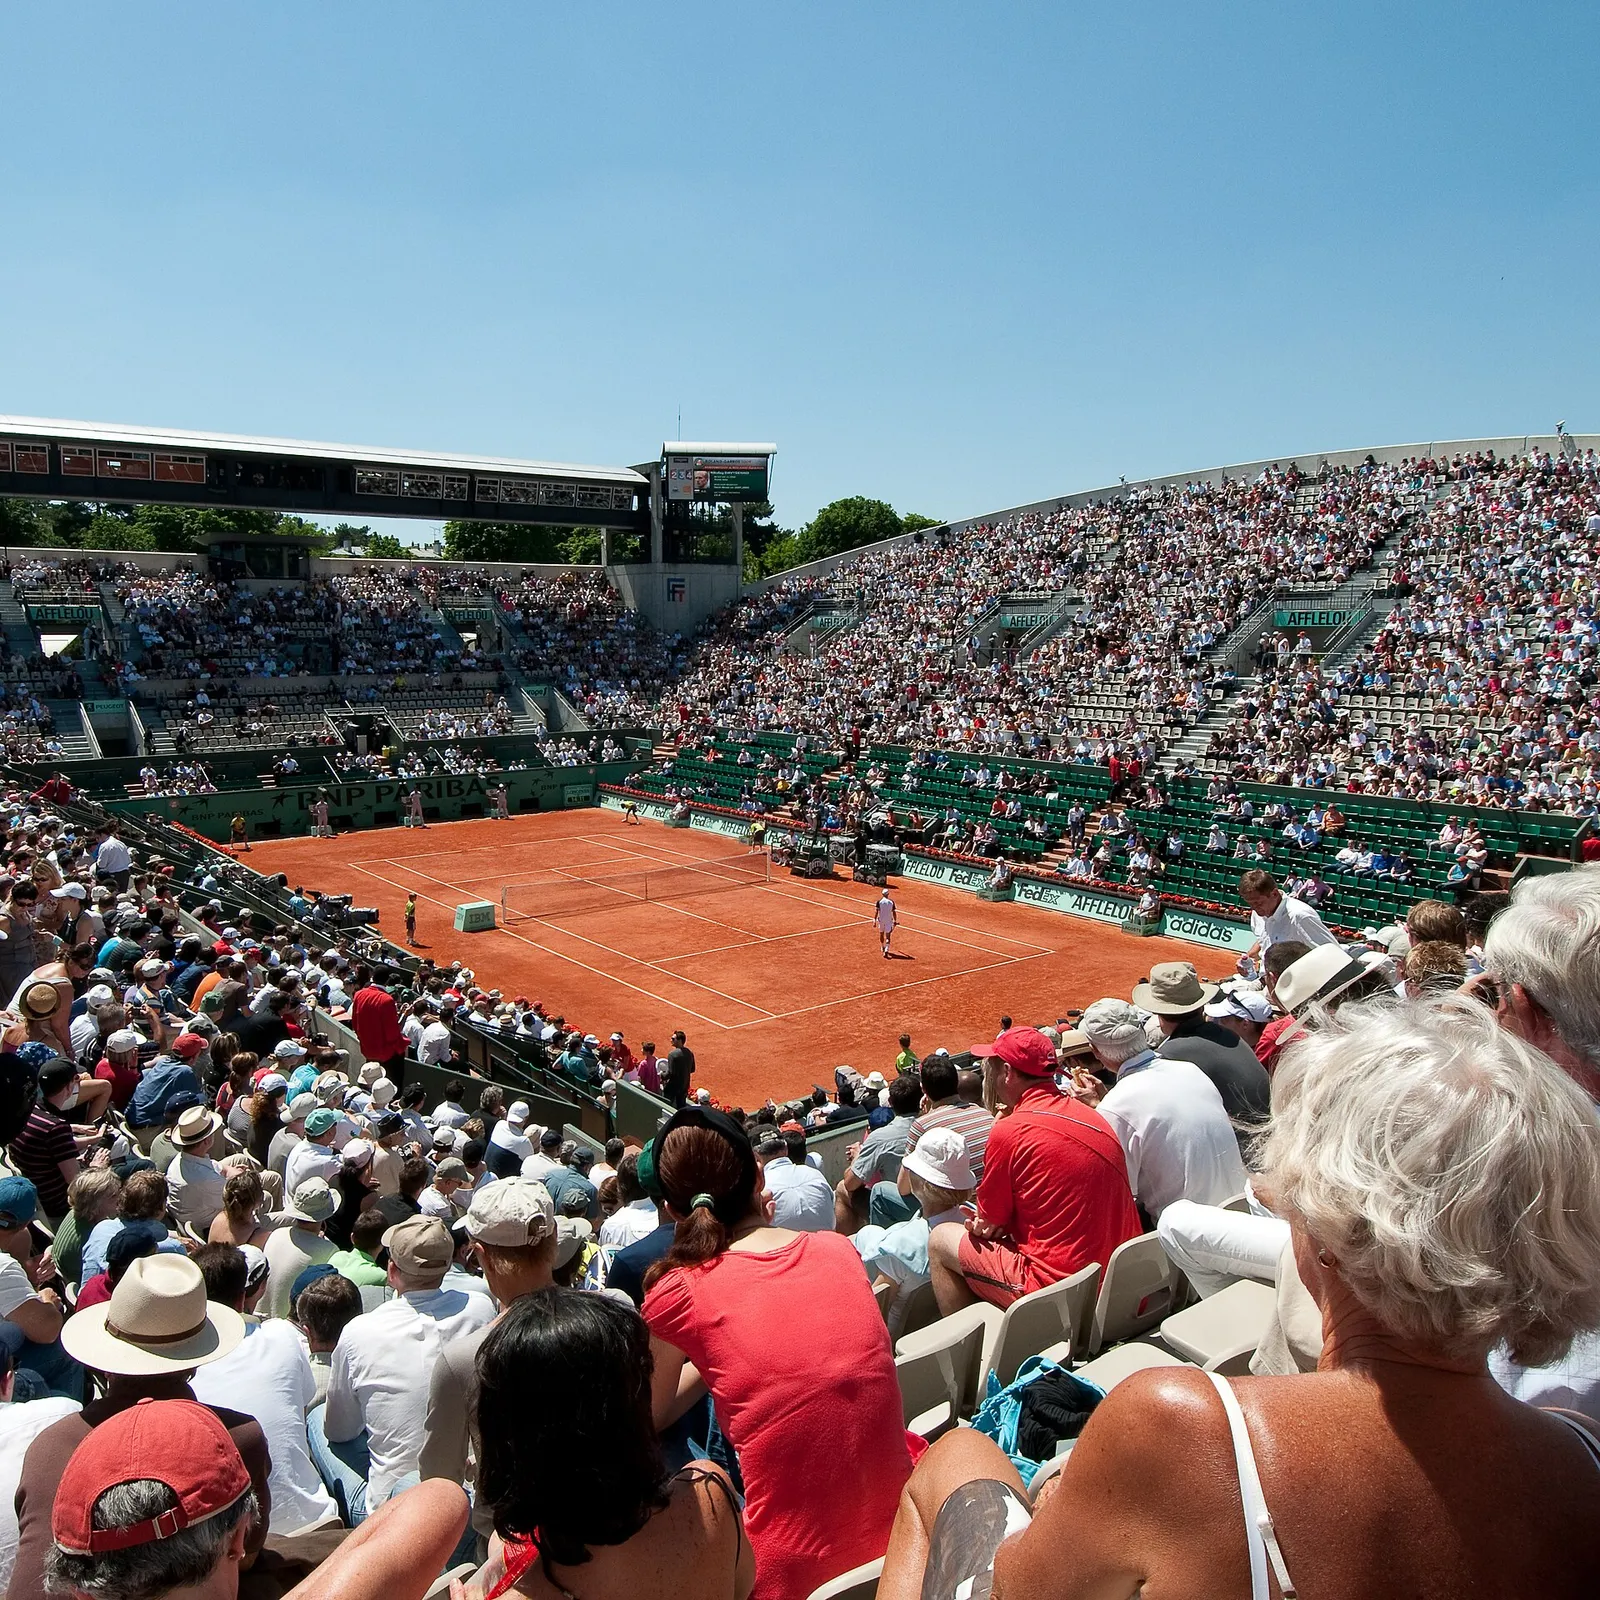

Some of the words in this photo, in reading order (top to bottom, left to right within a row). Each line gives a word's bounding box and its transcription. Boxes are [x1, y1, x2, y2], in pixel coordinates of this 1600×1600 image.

[36, 608, 93, 619] AFFLELOU
[1288, 611, 1351, 625] AFFLELOU
[298, 787, 365, 810] BNP
[375, 775, 500, 803] PARIBAS
[192, 812, 215, 821] BNP
[896, 858, 945, 879] AFFLELOU
[948, 867, 986, 888] FedEx
[1018, 882, 1060, 905] FedEx
[469, 912, 490, 923] IBM
[1170, 919, 1233, 942] adidas
